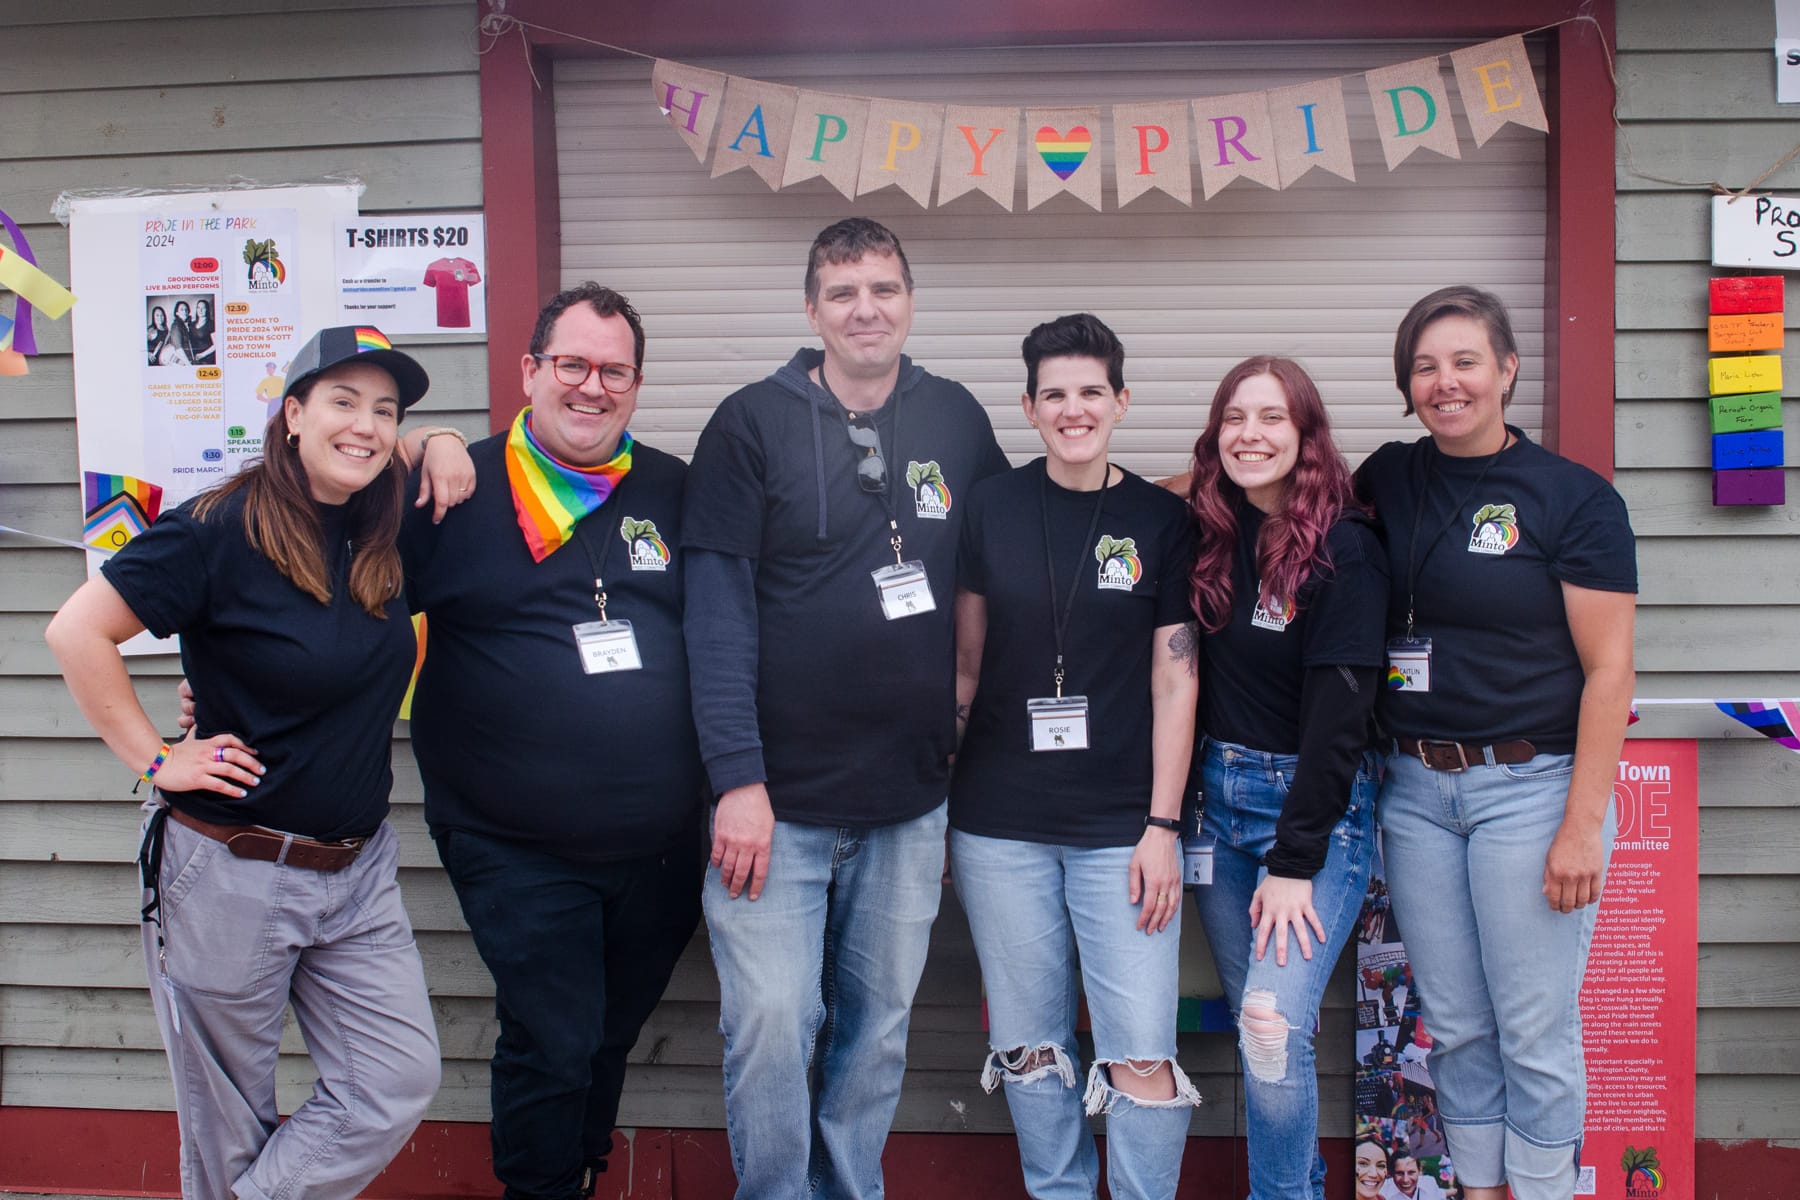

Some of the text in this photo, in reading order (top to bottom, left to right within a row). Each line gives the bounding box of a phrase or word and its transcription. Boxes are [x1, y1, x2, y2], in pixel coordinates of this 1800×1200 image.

[662, 59, 1523, 176] HAPPY PRIDE
[182, 218, 194, 231] IN
[200, 217, 221, 231] THE
[225, 216, 257, 230] PARK
[145, 234, 175, 247] 2024
[346, 226, 468, 248] T-SHIRTS $20
[248, 280, 278, 290] Minto
[917, 502, 945, 514] Minto
[1470, 538, 1505, 550] Minto
[632, 556, 664, 566] Minto
[1100, 574, 1132, 586] Minto
[898, 591, 917, 600] CHRIS
[1254, 610, 1284, 625] Minto
[592, 648, 626, 658] BRAYDEN
[1048, 726, 1070, 734] ROSIE
[1618, 760, 1670, 782] Town
[1614, 840, 1670, 850] ommittee
[1618, 863, 1653, 871] encourage
[1613, 869, 1640, 879] visibility
[1603, 886, 1624, 895] ounty.
[1605, 915, 1666, 925] and sexual identity
[1630, 924, 1657, 933] through
[1599, 932, 1612, 940] this
[1596, 957, 1623, 967] creating
[1626, 966, 1649, 975] people
[1619, 974, 1651, 984] impactful
[1593, 986, 1621, 996] changed
[1635, 986, 1648, 994] few
[1648, 986, 1666, 994] short
[1616, 995, 1634, 1004] hung
[1611, 1011, 1655, 1019] Pride themed
[1591, 1020, 1609, 1029] along
[1583, 1028, 1608, 1037] Beyond
[1612, 1036, 1630, 1044] work
[1590, 1057, 1655, 1066] important especially
[1588, 1065, 1623, 1074] Wellington
[1602, 1074, 1639, 1083] community
[1633, 1107, 1667, 1116] neighbors,
[1602, 1115, 1622, 1125] family
[1626, 1188, 1658, 1198] Minto
